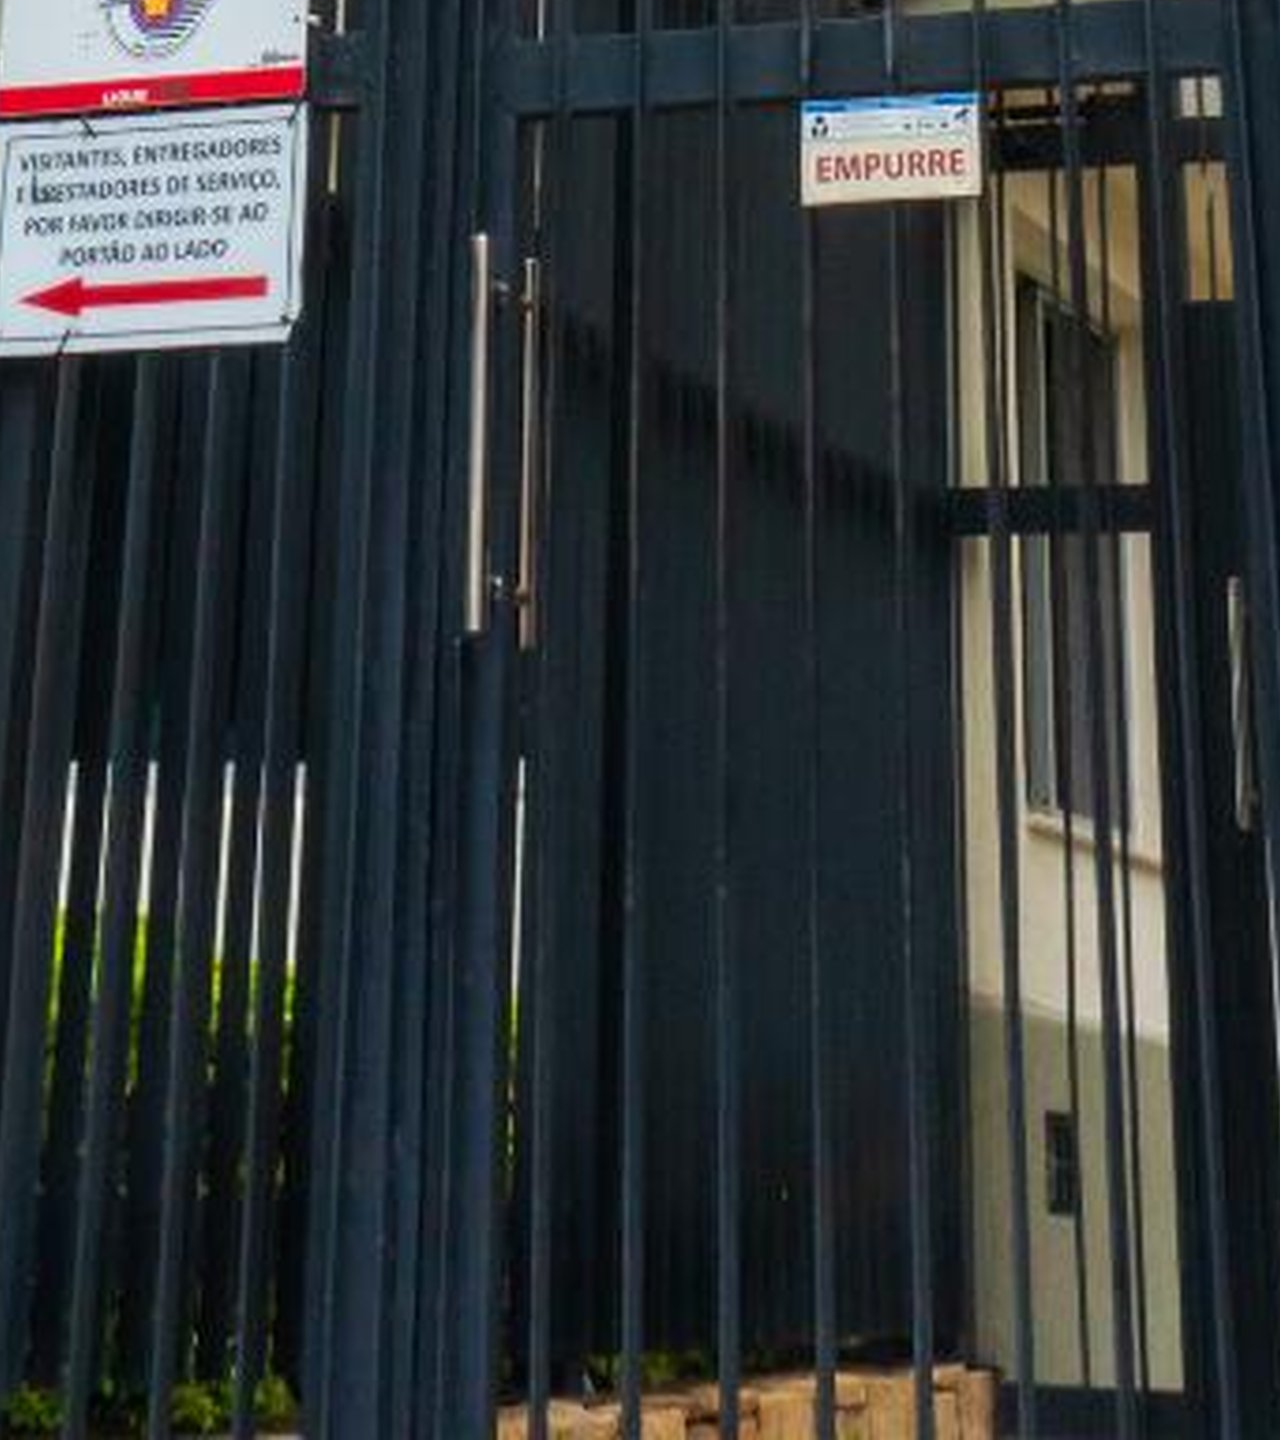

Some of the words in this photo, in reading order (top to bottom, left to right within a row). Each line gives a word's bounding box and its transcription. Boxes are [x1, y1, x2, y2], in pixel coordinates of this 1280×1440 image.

[133, 135, 282, 166] ENTREGADORES
[815, 148, 966, 183] EMPURRE
[166, 175, 189, 194] DE
[23, 215, 64, 237] POR
[70, 211, 128, 233] FAVOR
[239, 202, 269, 222] AO
[58, 240, 135, 267] PORTÃO
[140, 242, 169, 263] AO
[174, 239, 229, 261] LADO
